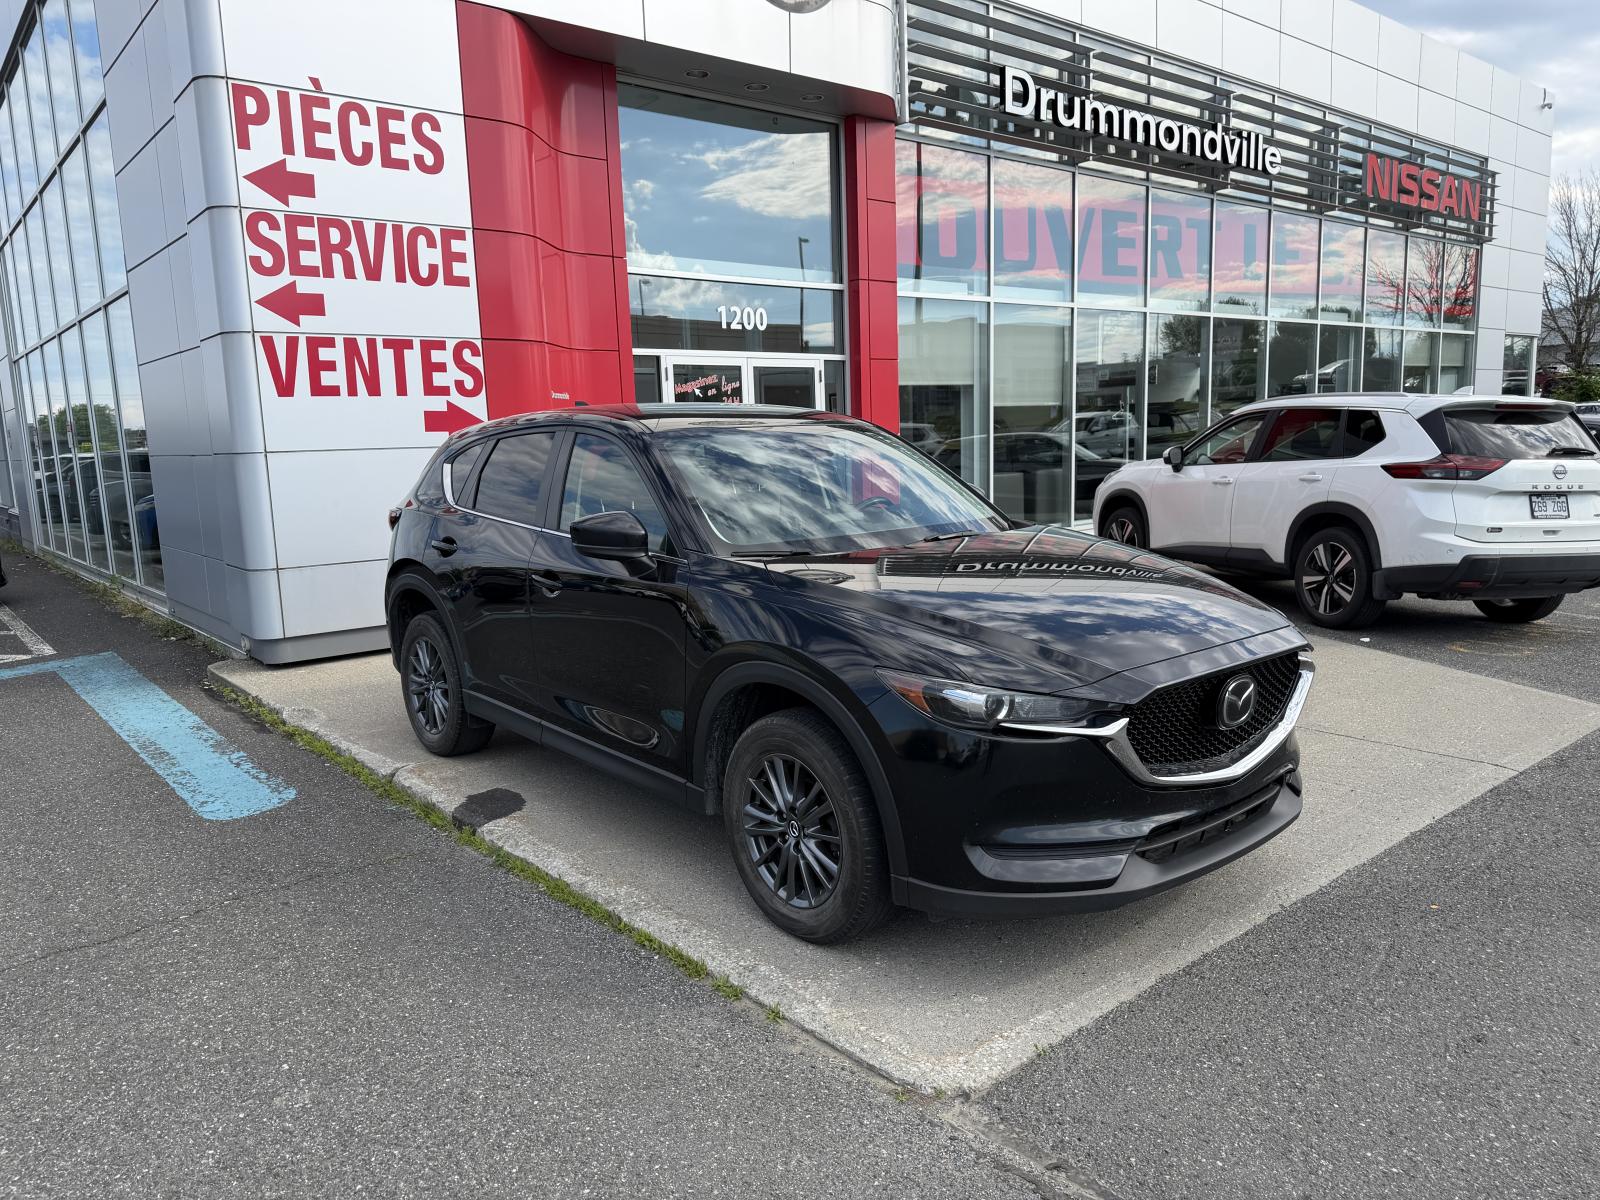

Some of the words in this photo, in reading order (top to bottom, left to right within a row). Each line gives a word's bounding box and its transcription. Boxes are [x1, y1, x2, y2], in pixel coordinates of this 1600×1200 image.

[231, 76, 446, 175] PIÈCES
[1003, 65, 1282, 175] Drummondville
[1366, 153, 1481, 221] NISSAN
[245, 211, 471, 287] SERVICE
[918, 202, 1222, 280] OUVERT
[717, 305, 768, 331] 1200
[260, 335, 484, 398] VENTES
